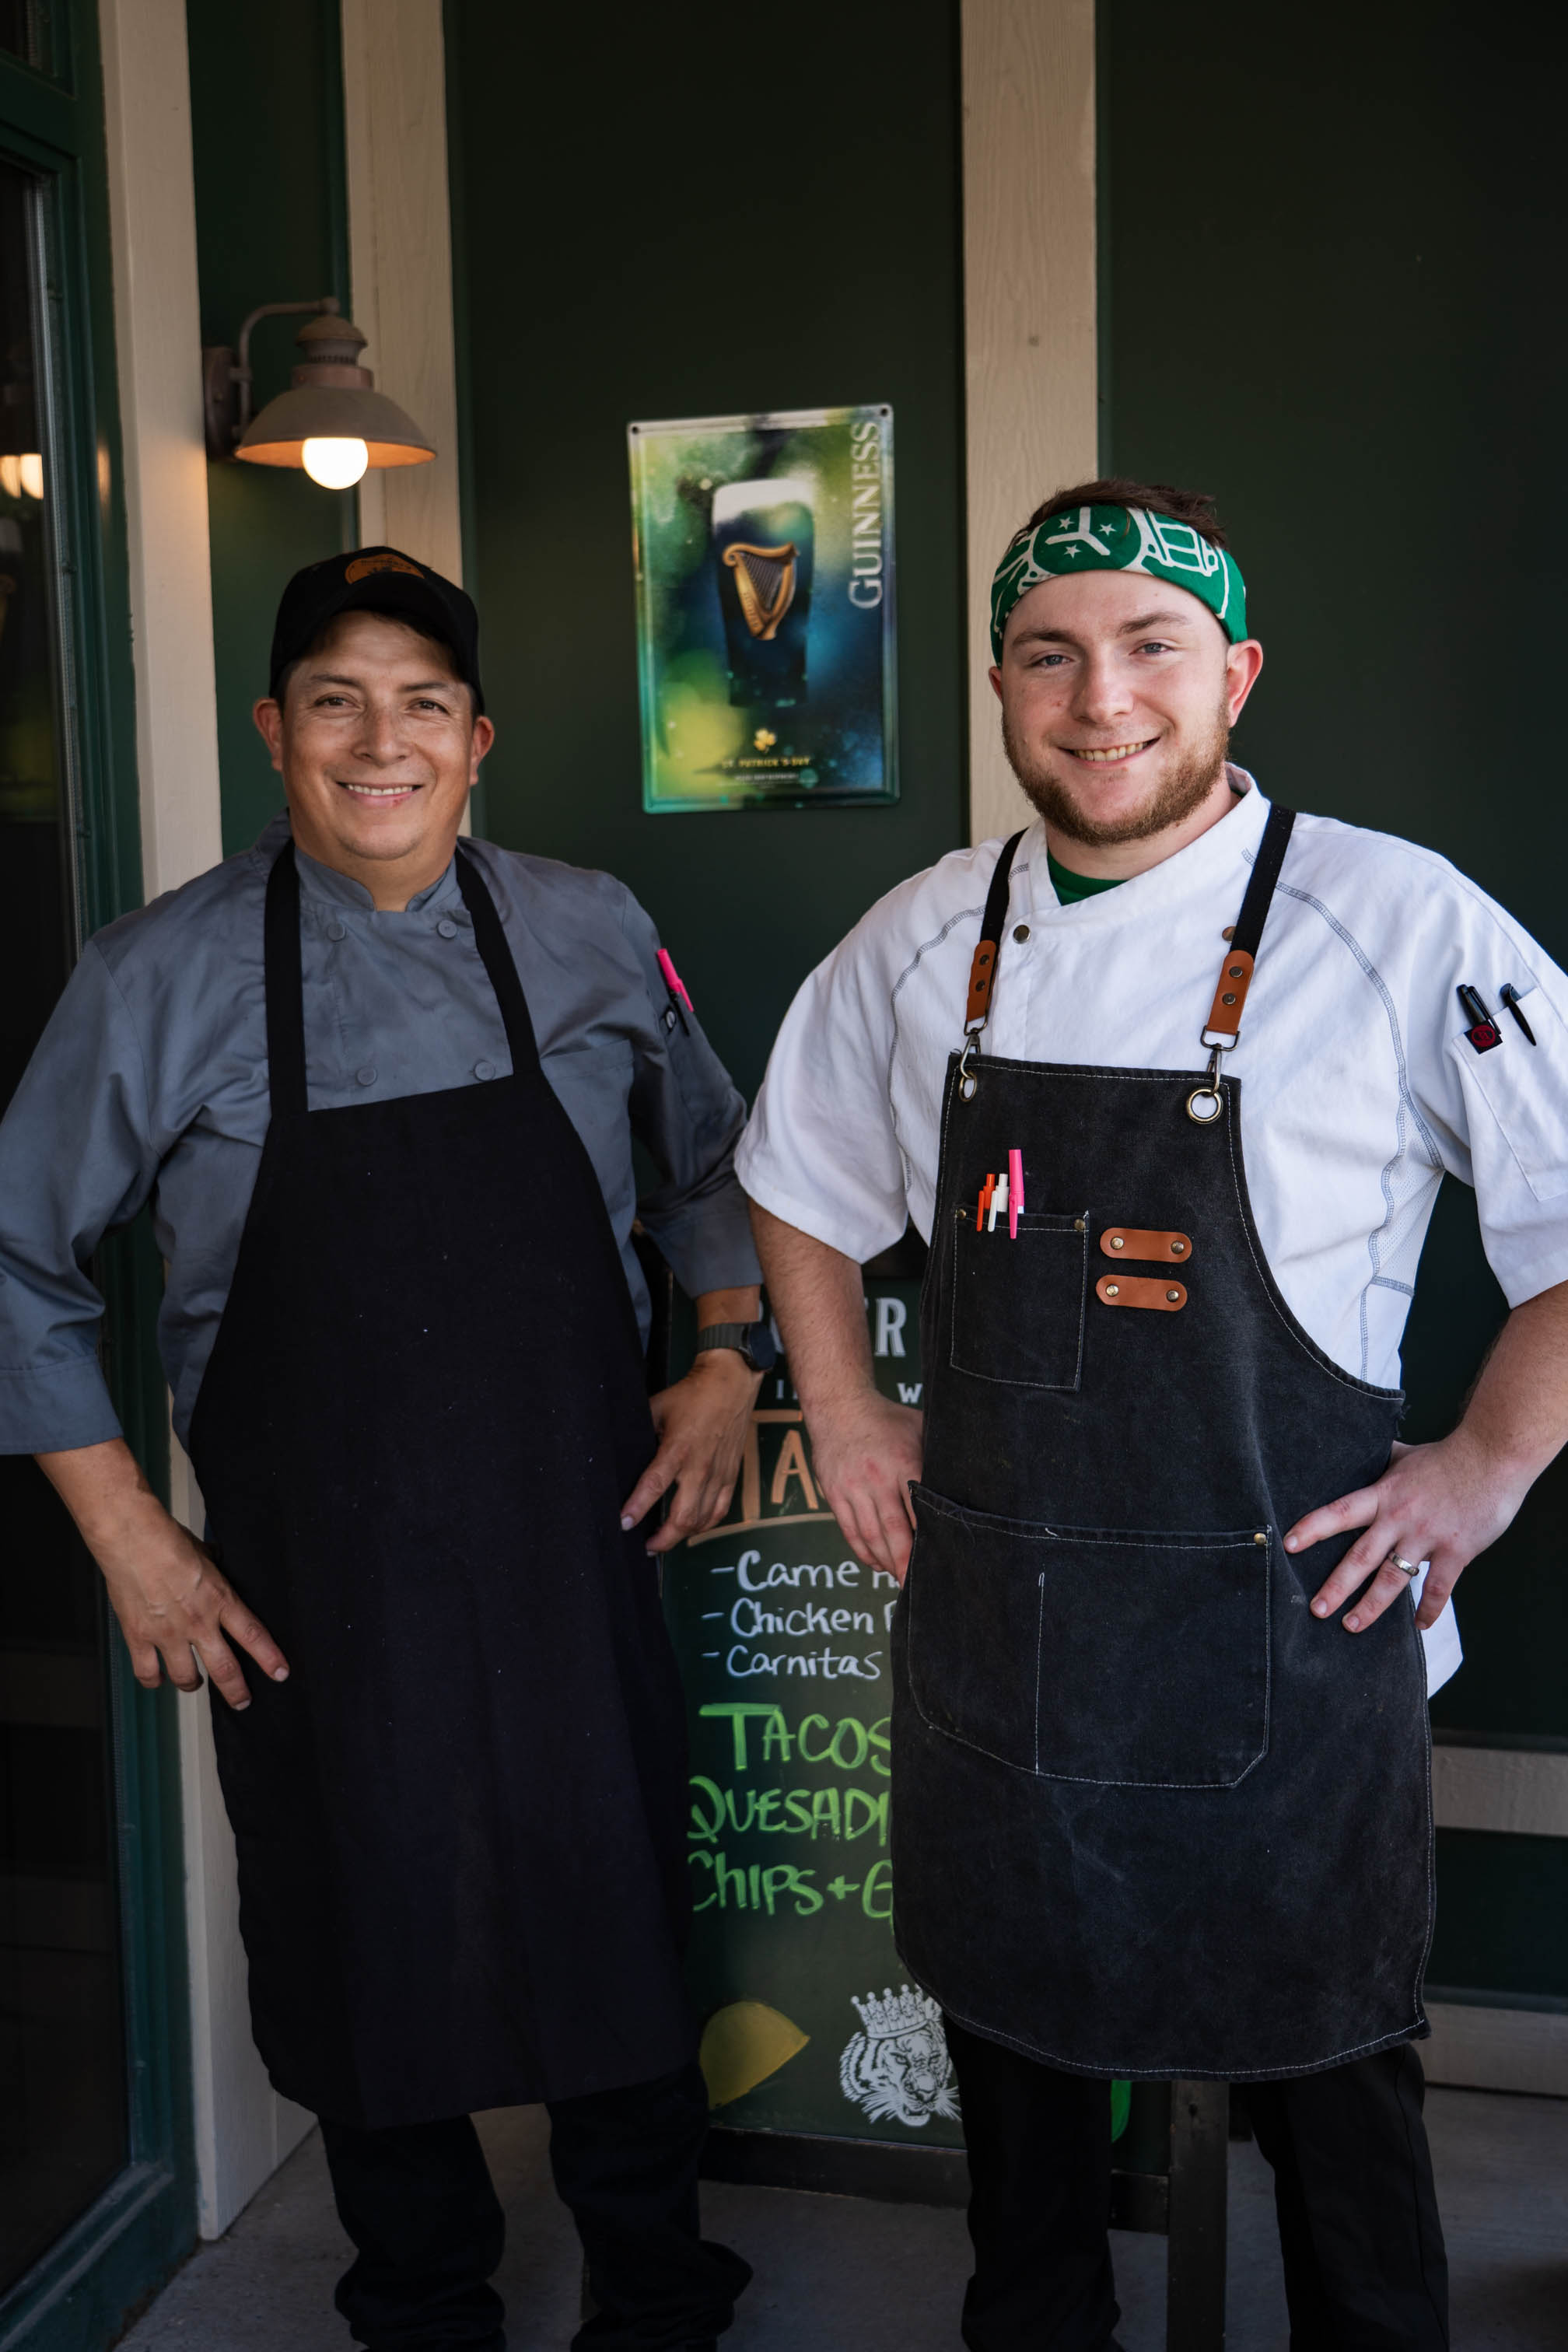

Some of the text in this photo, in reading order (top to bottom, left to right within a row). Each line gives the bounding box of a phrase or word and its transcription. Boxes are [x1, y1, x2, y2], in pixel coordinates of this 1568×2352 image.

[848, 420, 884, 610] GUINNESS
[743, 1409, 827, 1524] TA
[698, 1702, 891, 1776] TACOS
